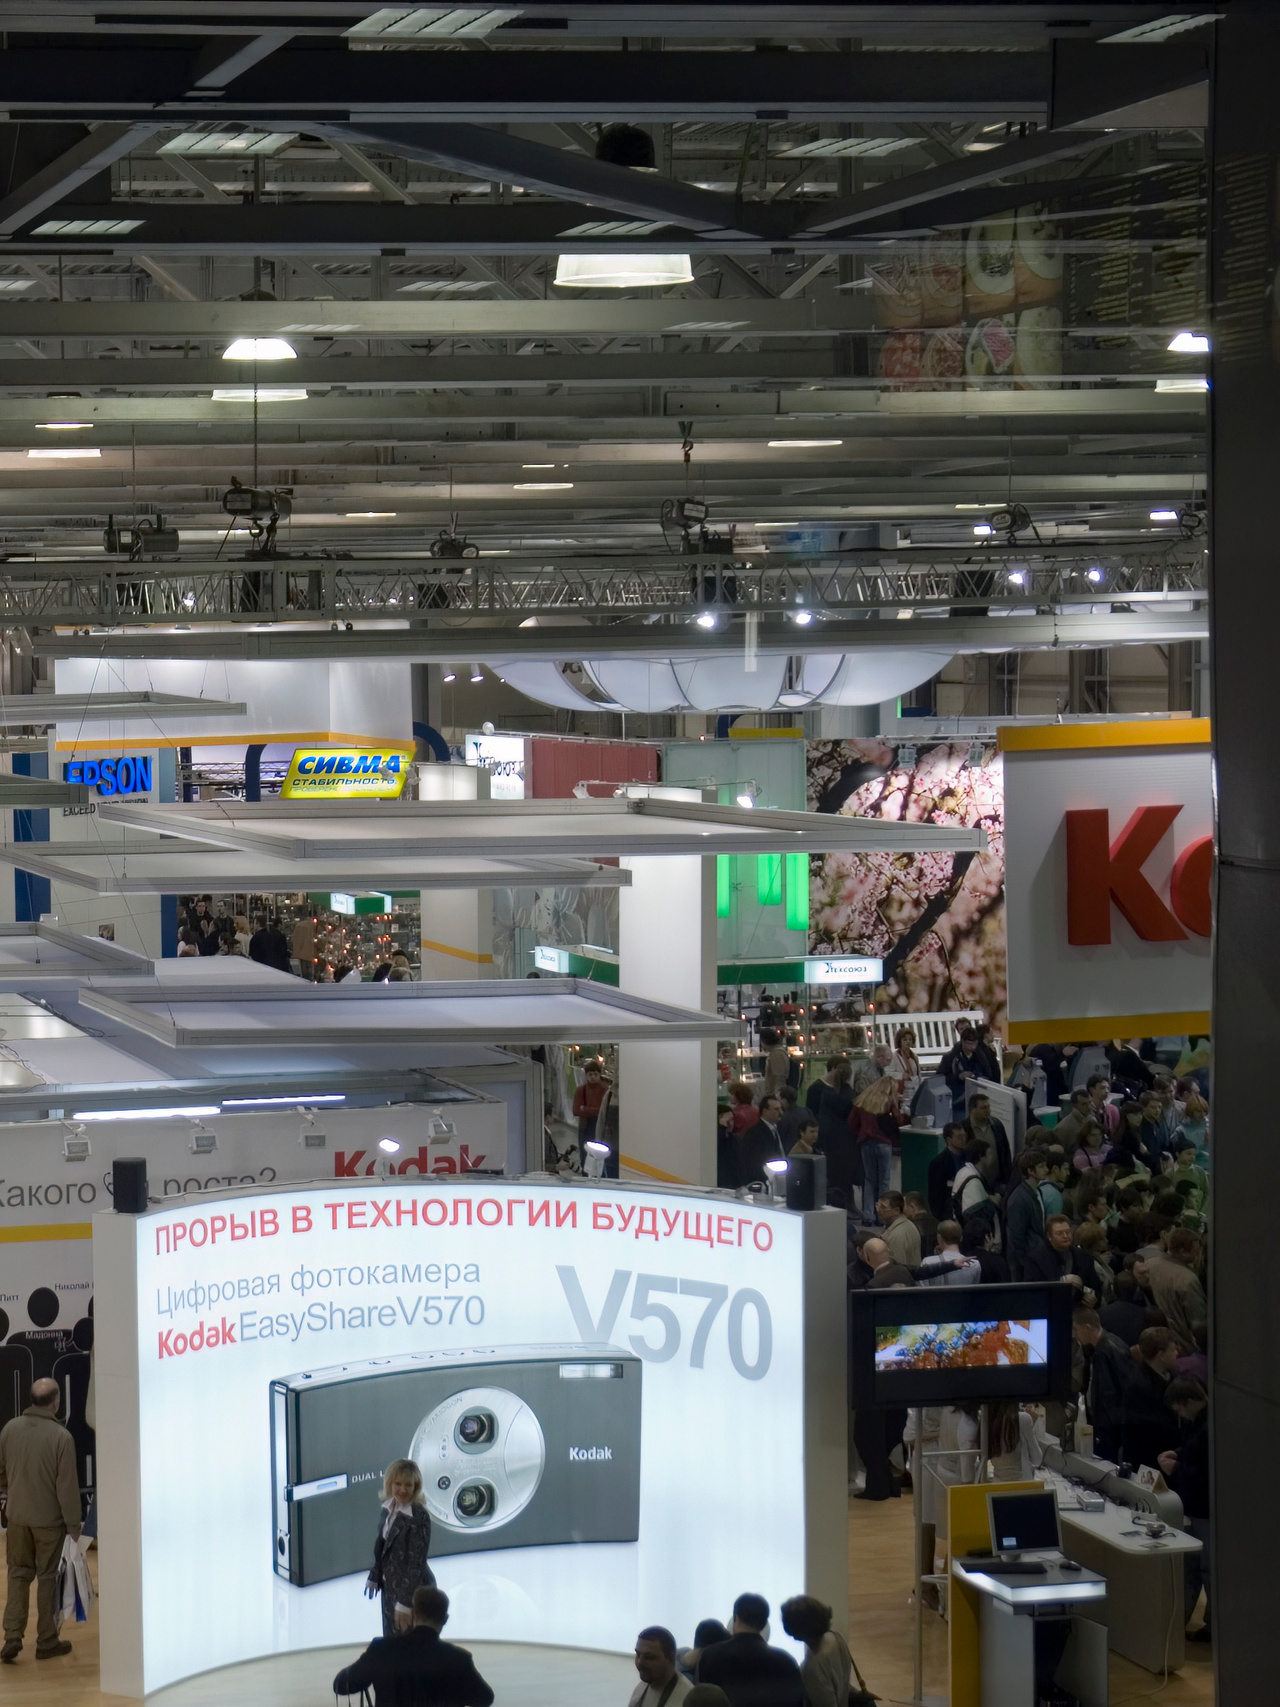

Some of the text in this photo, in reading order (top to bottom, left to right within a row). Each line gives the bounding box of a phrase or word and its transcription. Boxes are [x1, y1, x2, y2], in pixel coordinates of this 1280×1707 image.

[298, 755, 400, 774] СИВМА
[63, 756, 152, 796] EPSON
[63, 803, 96, 817] EXCEED
[156, 1199, 773, 1256] ПРОРЫВ В ТЕХНОЛОГИИ БУДУЩЕГО
[54, 1282, 90, 1290] Николай
[157, 1263, 481, 1318] Цифровая фотокамера
[0, 1294, 20, 1302] Питт
[555, 1265, 773, 1381] V570
[25, 1331, 63, 1340] Мадонна
[158, 1317, 237, 1359] Kodak
[569, 1446, 612, 1461] Kodak
[351, 1472, 376, 1483] DUAL
